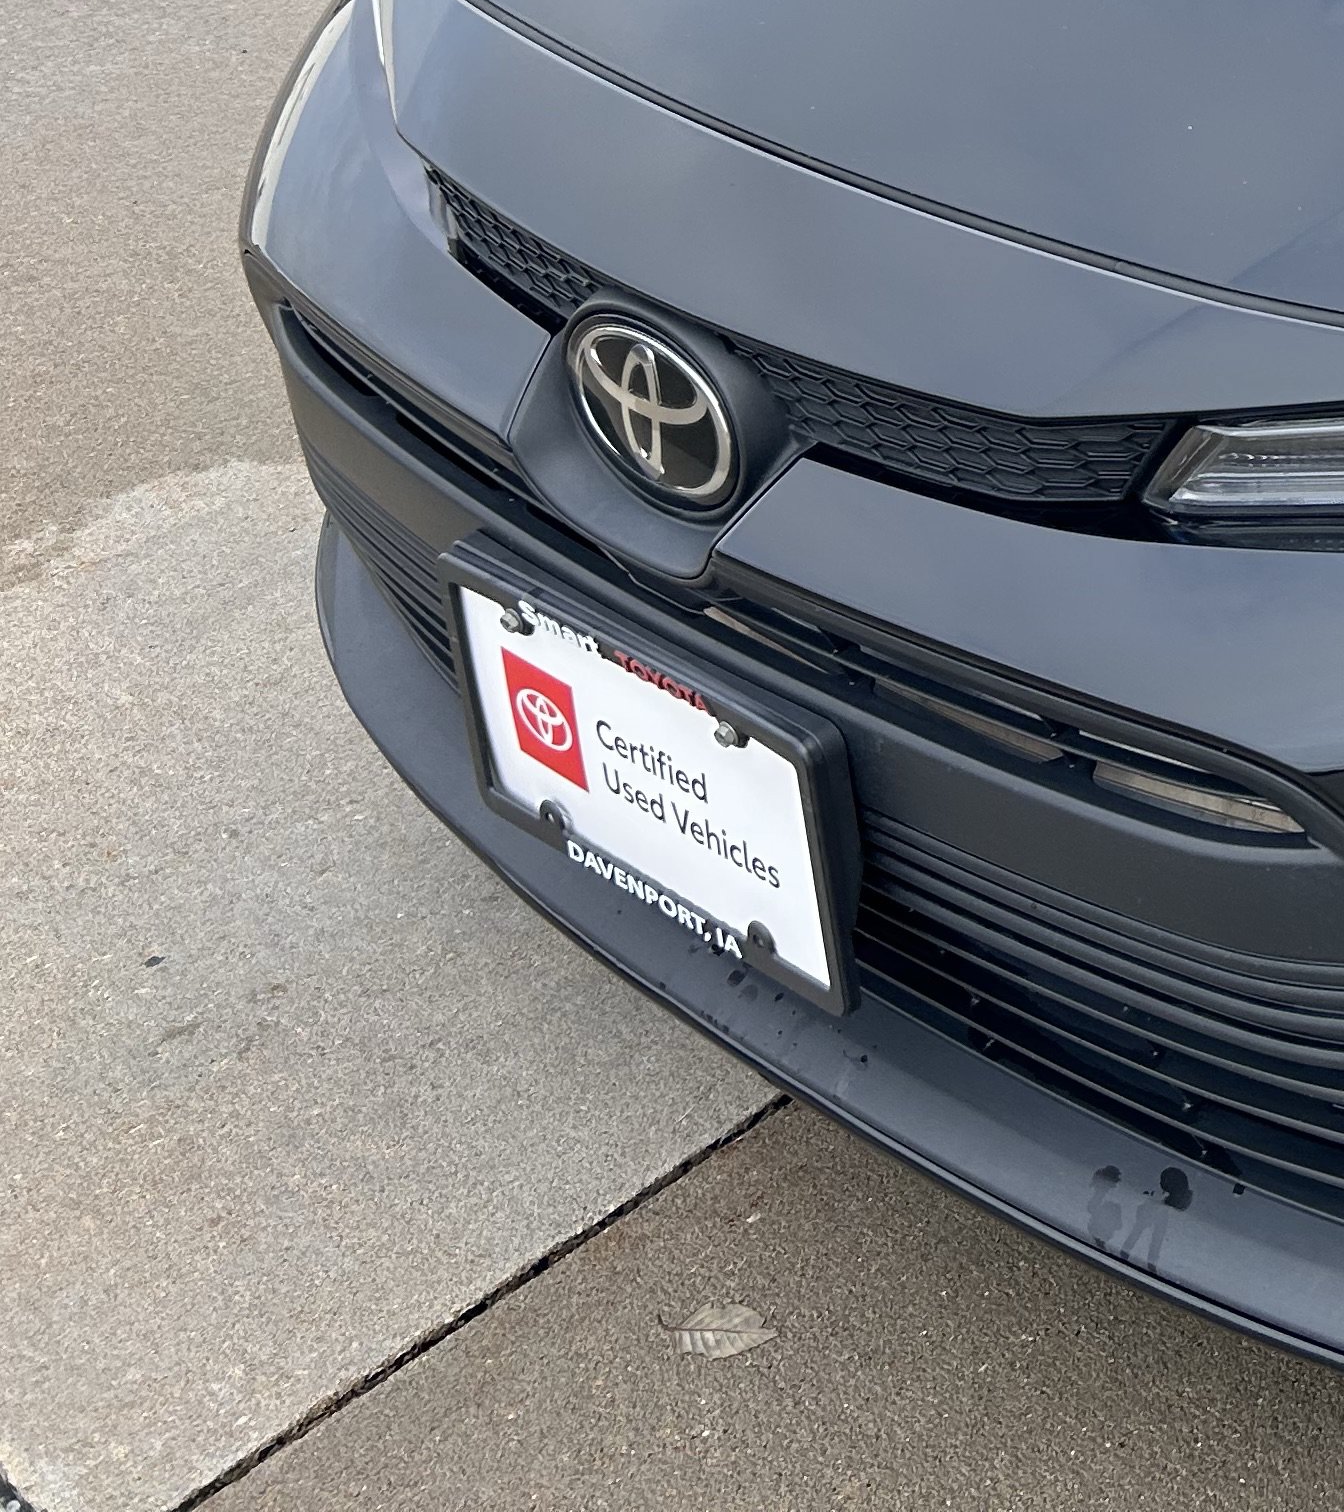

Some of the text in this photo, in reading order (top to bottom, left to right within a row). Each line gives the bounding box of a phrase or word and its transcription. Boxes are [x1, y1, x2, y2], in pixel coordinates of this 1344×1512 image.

[518, 600, 711, 712] Smart TOYOTA
[596, 719, 709, 804] Certified
[602, 763, 780, 889] Used Vehicles
[567, 840, 743, 959] DAVENPORT, IA
